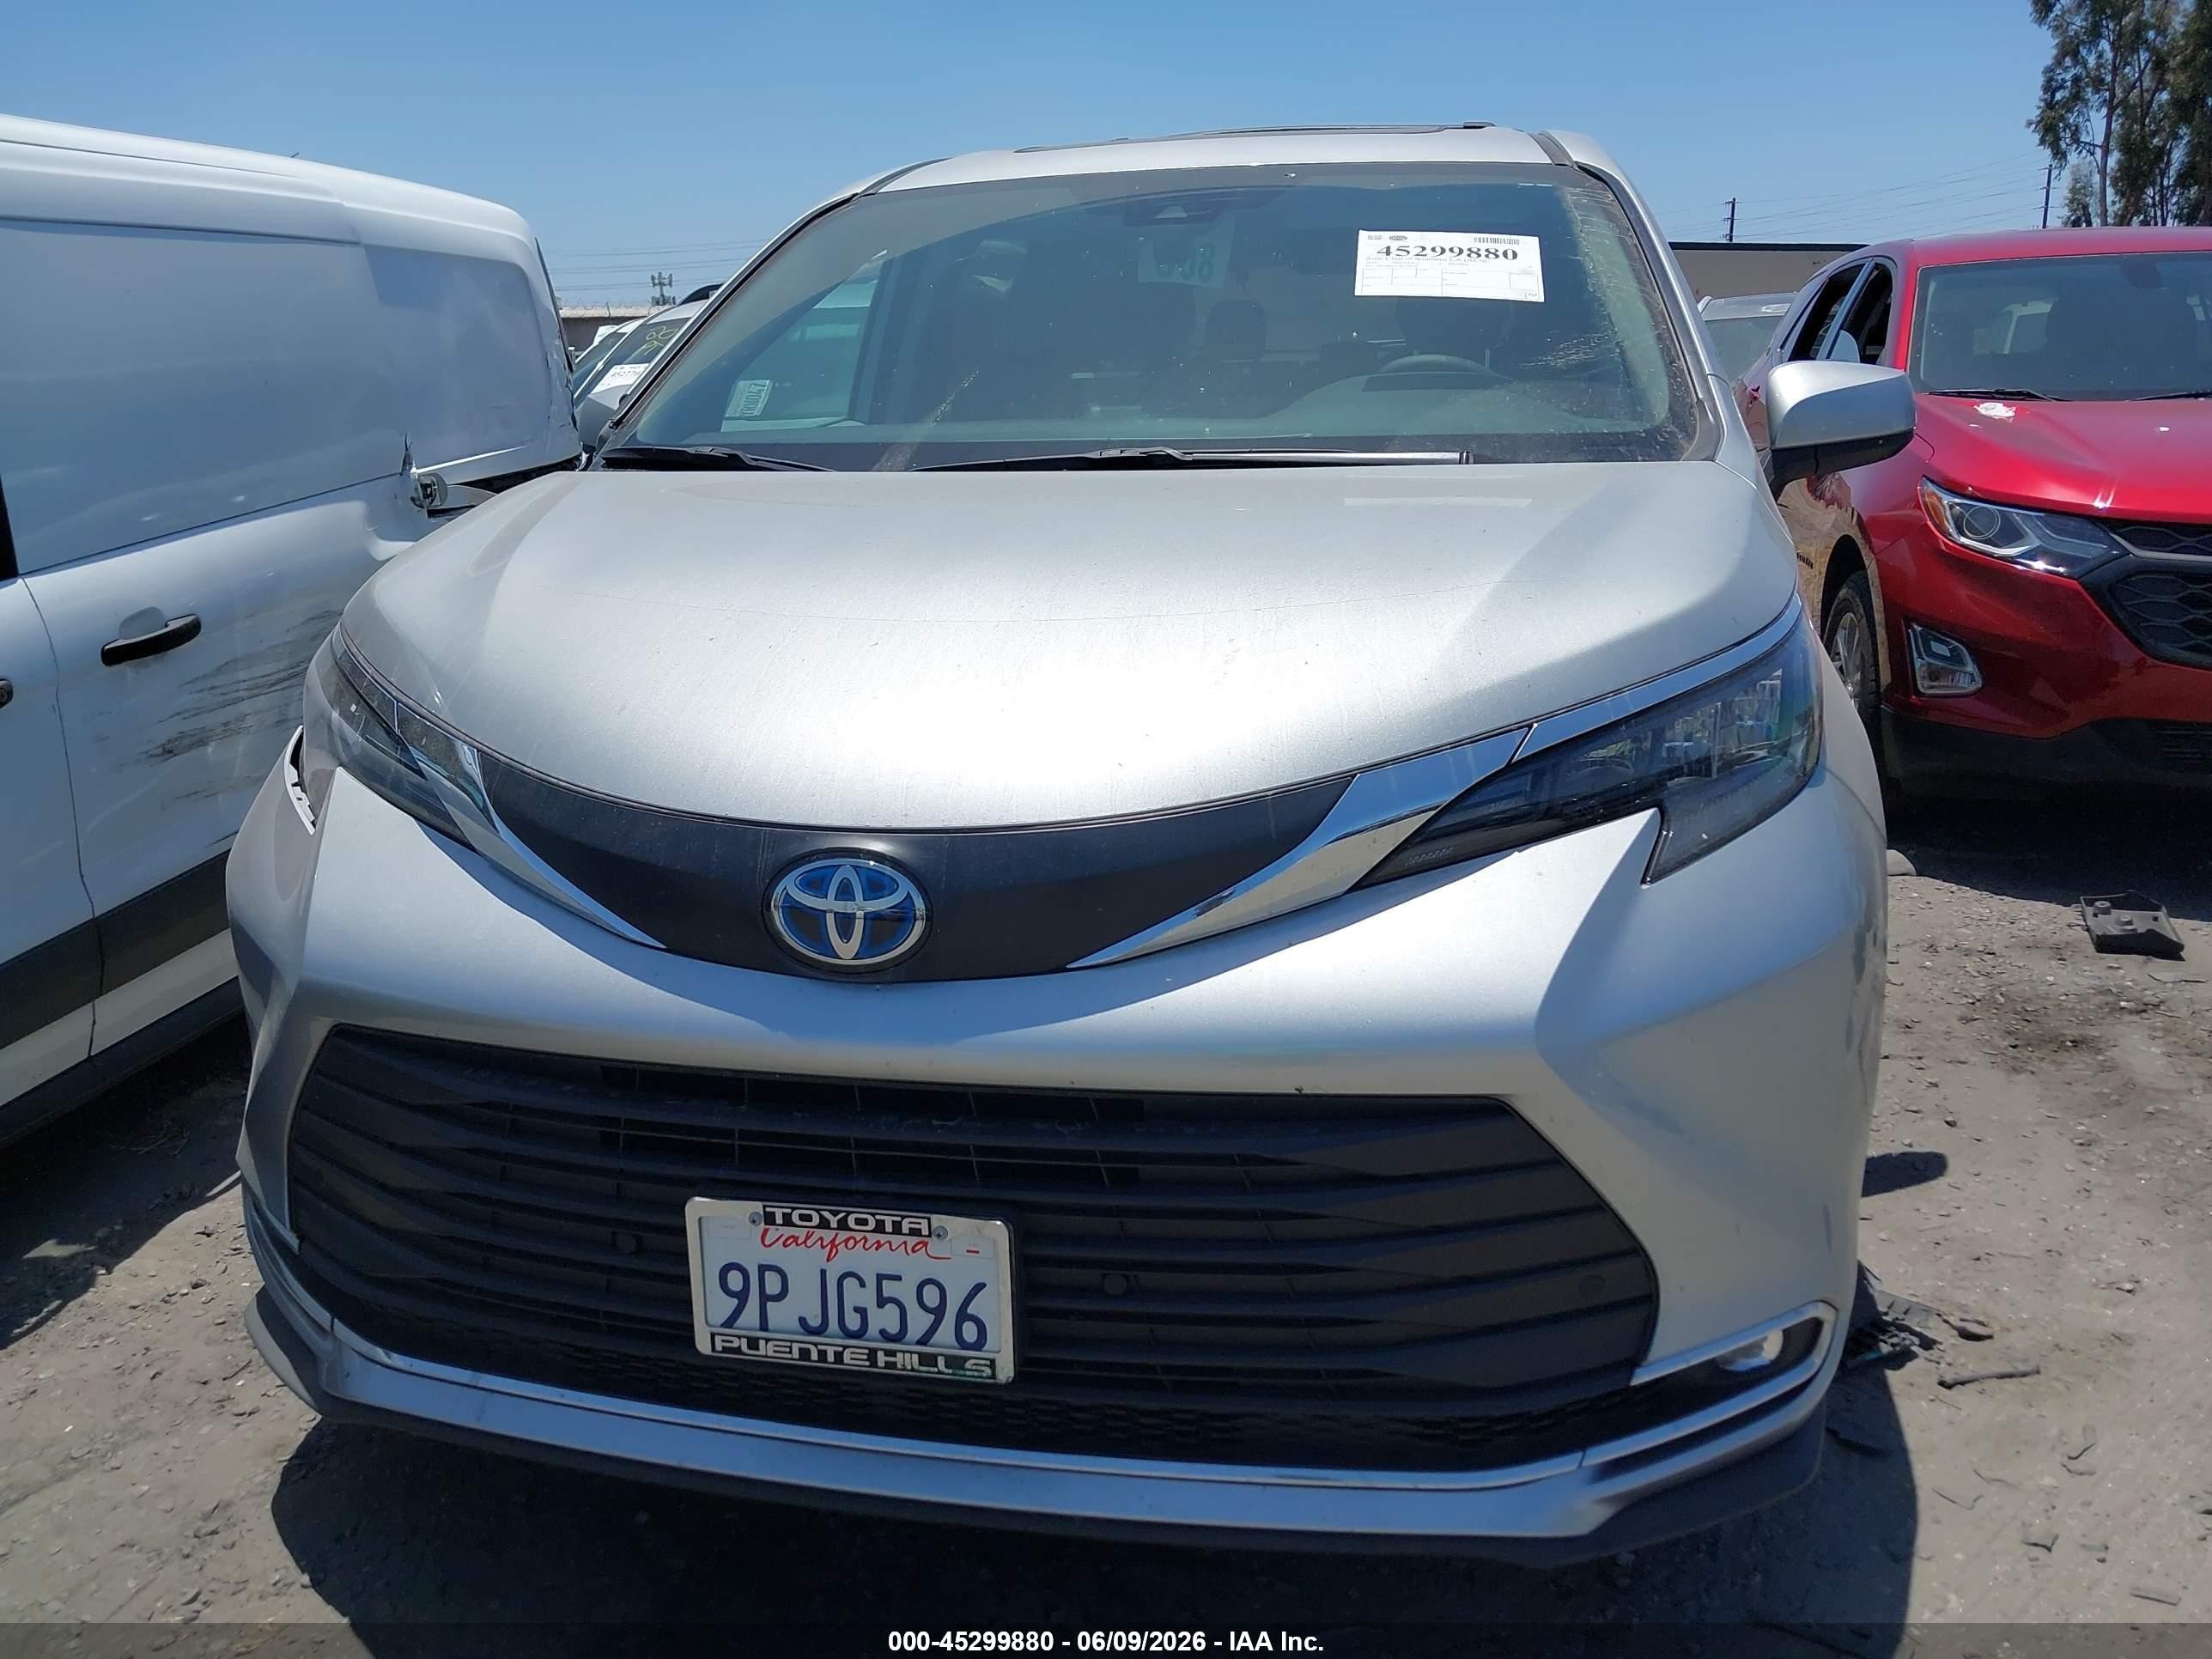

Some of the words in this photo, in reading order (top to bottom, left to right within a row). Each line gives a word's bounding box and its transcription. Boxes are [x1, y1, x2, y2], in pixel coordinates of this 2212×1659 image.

[1376, 245, 1518, 260] 45299880
[765, 1206, 930, 1236] TOYOTA
[760, 1227, 951, 1262] California
[718, 1261, 988, 1352] 9PJG596
[714, 1335, 870, 1368] PUENTE
[877, 1352, 992, 1377] HILLS
